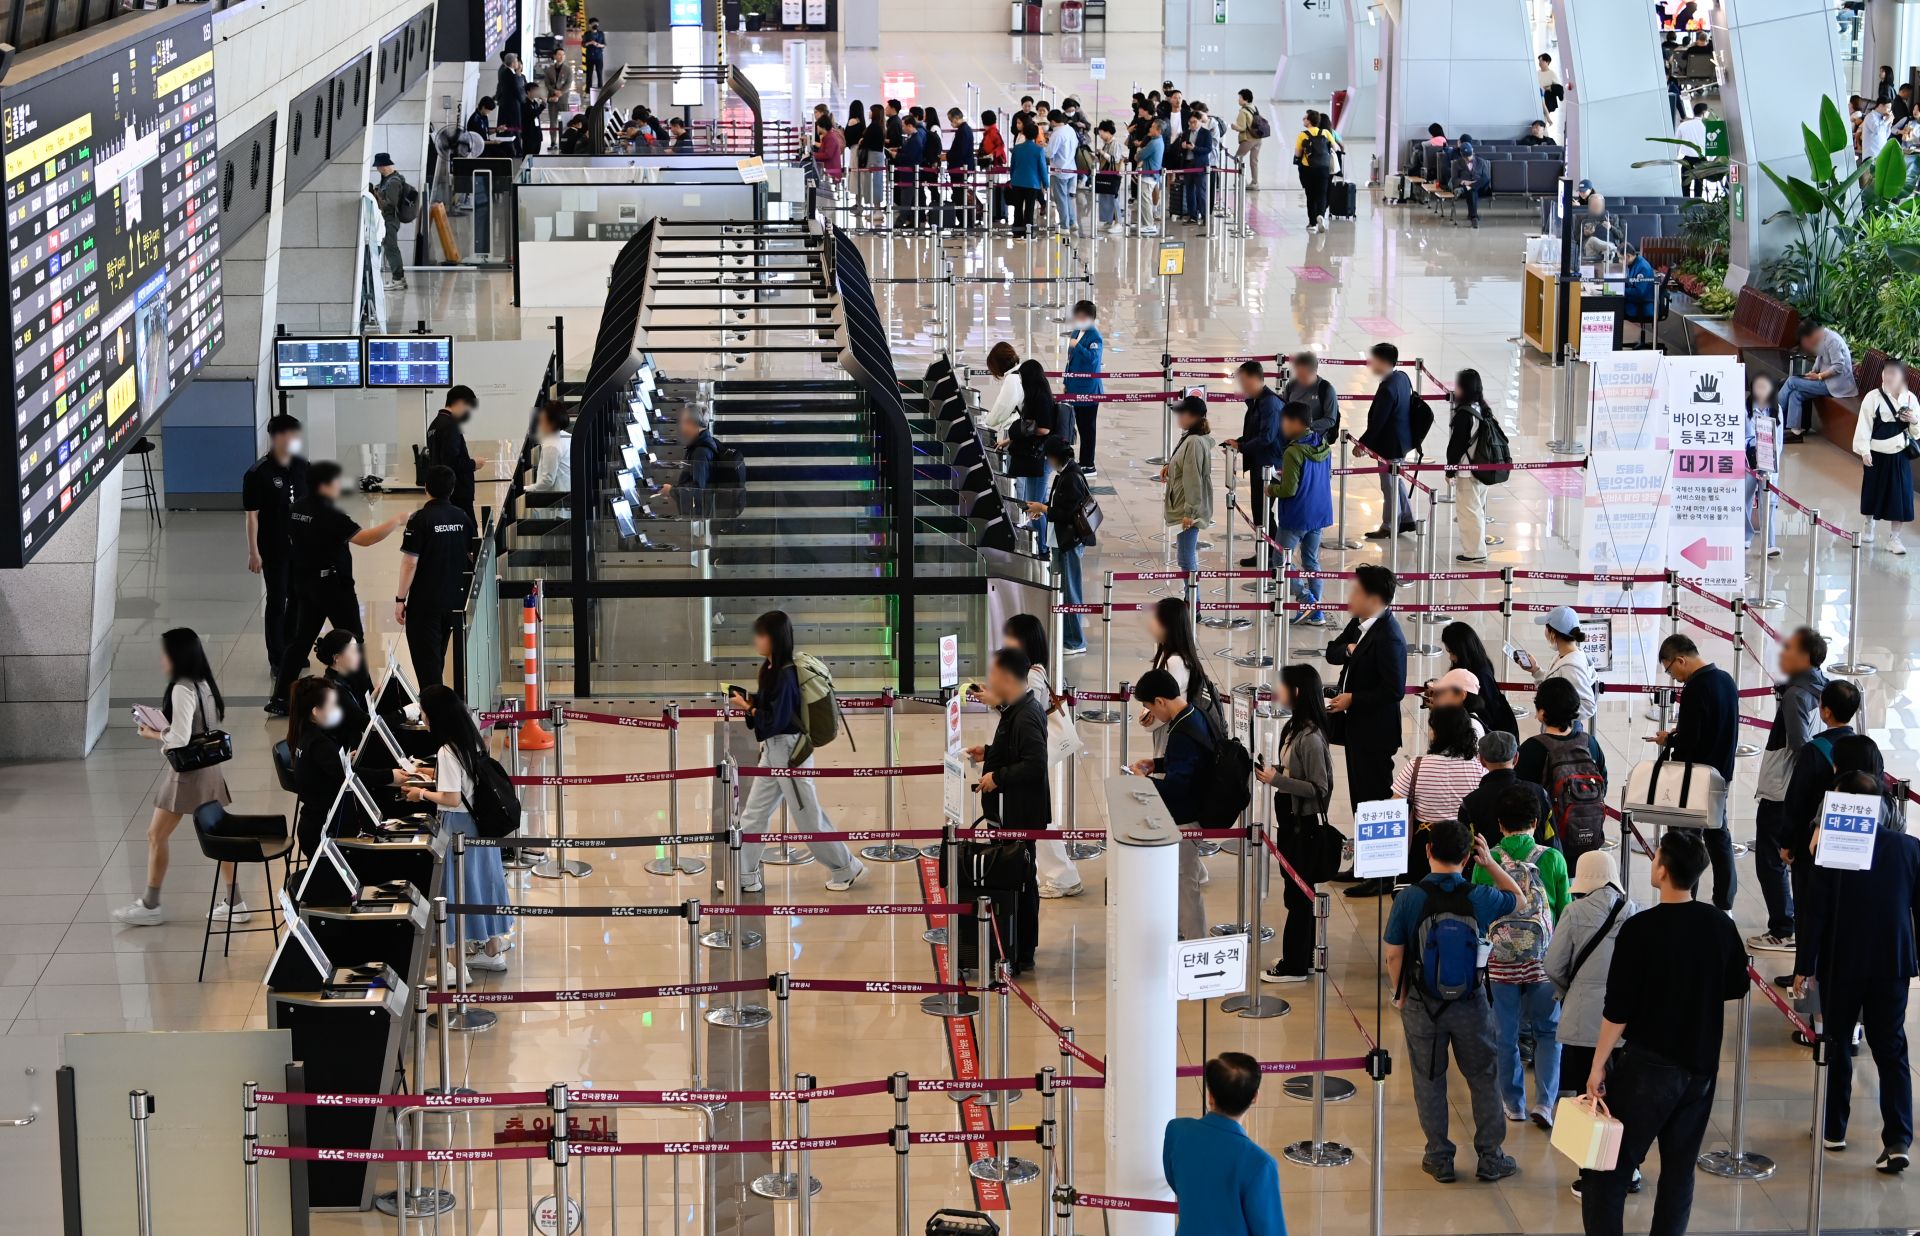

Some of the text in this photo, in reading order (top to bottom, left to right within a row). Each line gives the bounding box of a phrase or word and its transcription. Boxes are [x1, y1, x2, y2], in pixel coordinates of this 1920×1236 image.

[1673, 412, 1740, 428] 바이오정보
[1680, 430, 1734, 446] 등록고객
[1679, 454, 1734, 474] 대기줄
[434, 523, 464, 534] SECURITY
[1299, 571, 1315, 579] KAC
[1528, 571, 1544, 579] KAC
[1594, 574, 1610, 582] KAC
[1704, 577, 1738, 585] 한국공항공사
[1053, 606, 1069, 614] KAC
[1299, 603, 1316, 611] KAC
[1528, 604, 1544, 612] KAC
[1594, 606, 1610, 614] KAC
[1583, 643, 1607, 653] 신분증
[619, 717, 637, 726] KAC
[625, 772, 675, 782] KAC 한국공항공사
[771, 768, 821, 777] KAC 한국공항공사
[853, 768, 903, 777] KAC 한국공항공사
[542, 777, 592, 785] KAC 한국공항공사
[1830, 802, 1873, 815] 항공기탑승
[1361, 810, 1402, 822] 항공기탑승
[1828, 816, 1873, 832] 대기줄
[974, 829, 1027, 838] KAC 한국공항공사
[1062, 831, 1083, 839] KAC
[1361, 823, 1403, 838] 대기줄
[660, 835, 715, 844] KAC 한국공항공사
[761, 833, 813, 842] KAC 한국공항공사
[848, 831, 900, 840] KAC 한국공항공사
[464, 838, 496, 846] 한국공항공사
[551, 839, 606, 847] KAC 한국공항공사
[496, 906, 554, 915] KAC 한국공항공사
[611, 907, 669, 916] KAC 한국공항공사
[702, 906, 735, 914] 한국공항공사
[773, 906, 830, 915] KAC 한국공항공사
[867, 905, 924, 914] KAC 한국공항공사
[1183, 947, 1240, 968] 단체 승객
[658, 984, 719, 996] KAC 한국공항공사
[866, 982, 923, 992] KAC 한국공항공사
[452, 993, 514, 1003] KAC 한국공항공사
[556, 990, 617, 1000] KAC 한국공항공사
[961, 1059, 973, 1074] Please
[1260, 1063, 1297, 1072] 한국공항공사
[918, 1080, 983, 1091] KAC 한국공항공사
[581, 1092, 619, 1101] 한국공항공사
[662, 1091, 728, 1102] KAC 한국공항공사
[770, 1088, 835, 1101] KAC 한국공항공사
[317, 1094, 383, 1105] KAC 한국공항공사
[426, 1095, 492, 1105] KAC 한국공항공사
[920, 1132, 985, 1143] KAC 한국공항공사
[584, 1144, 622, 1153] 한국공항공사
[664, 1143, 730, 1153] KAC 한국공항공사
[772, 1138, 837, 1151] KAC 한국공항공사
[318, 1149, 384, 1160] KAC 한국공항공사
[427, 1150, 493, 1161] KAC 한국공항공사
[1090, 1197, 1131, 1208] 한국공항공사
